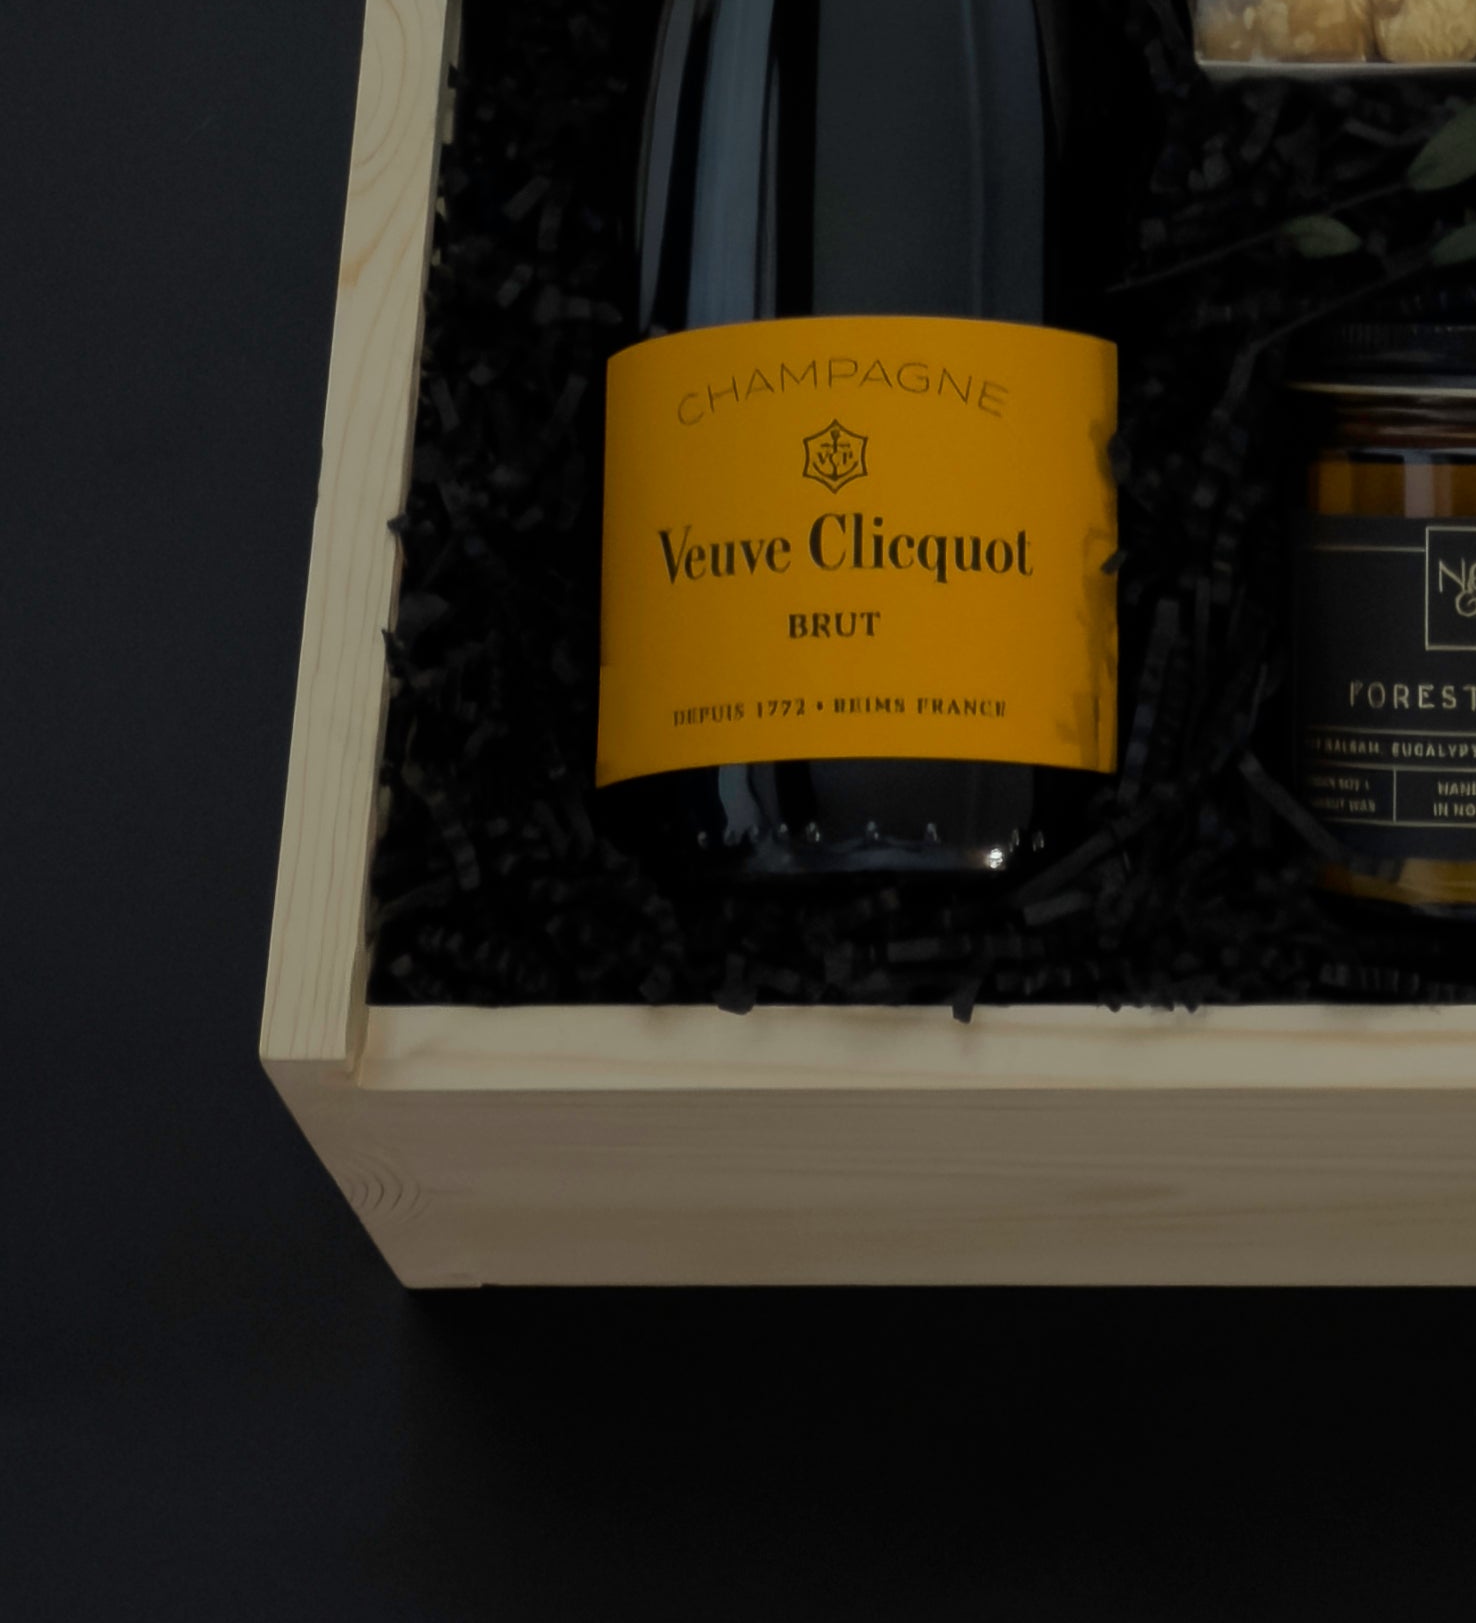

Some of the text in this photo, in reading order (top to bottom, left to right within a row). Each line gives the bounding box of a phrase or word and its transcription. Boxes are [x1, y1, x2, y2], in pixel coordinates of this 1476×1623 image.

[676, 357, 1009, 427] CHAMPAGNE
[657, 513, 1034, 585] Veuve Clicquot
[787, 611, 880, 639] BRUT
[673, 695, 1007, 728] DEPUIS 1772 REIMS FRANCE
[1432, 802, 1448, 818] IN
